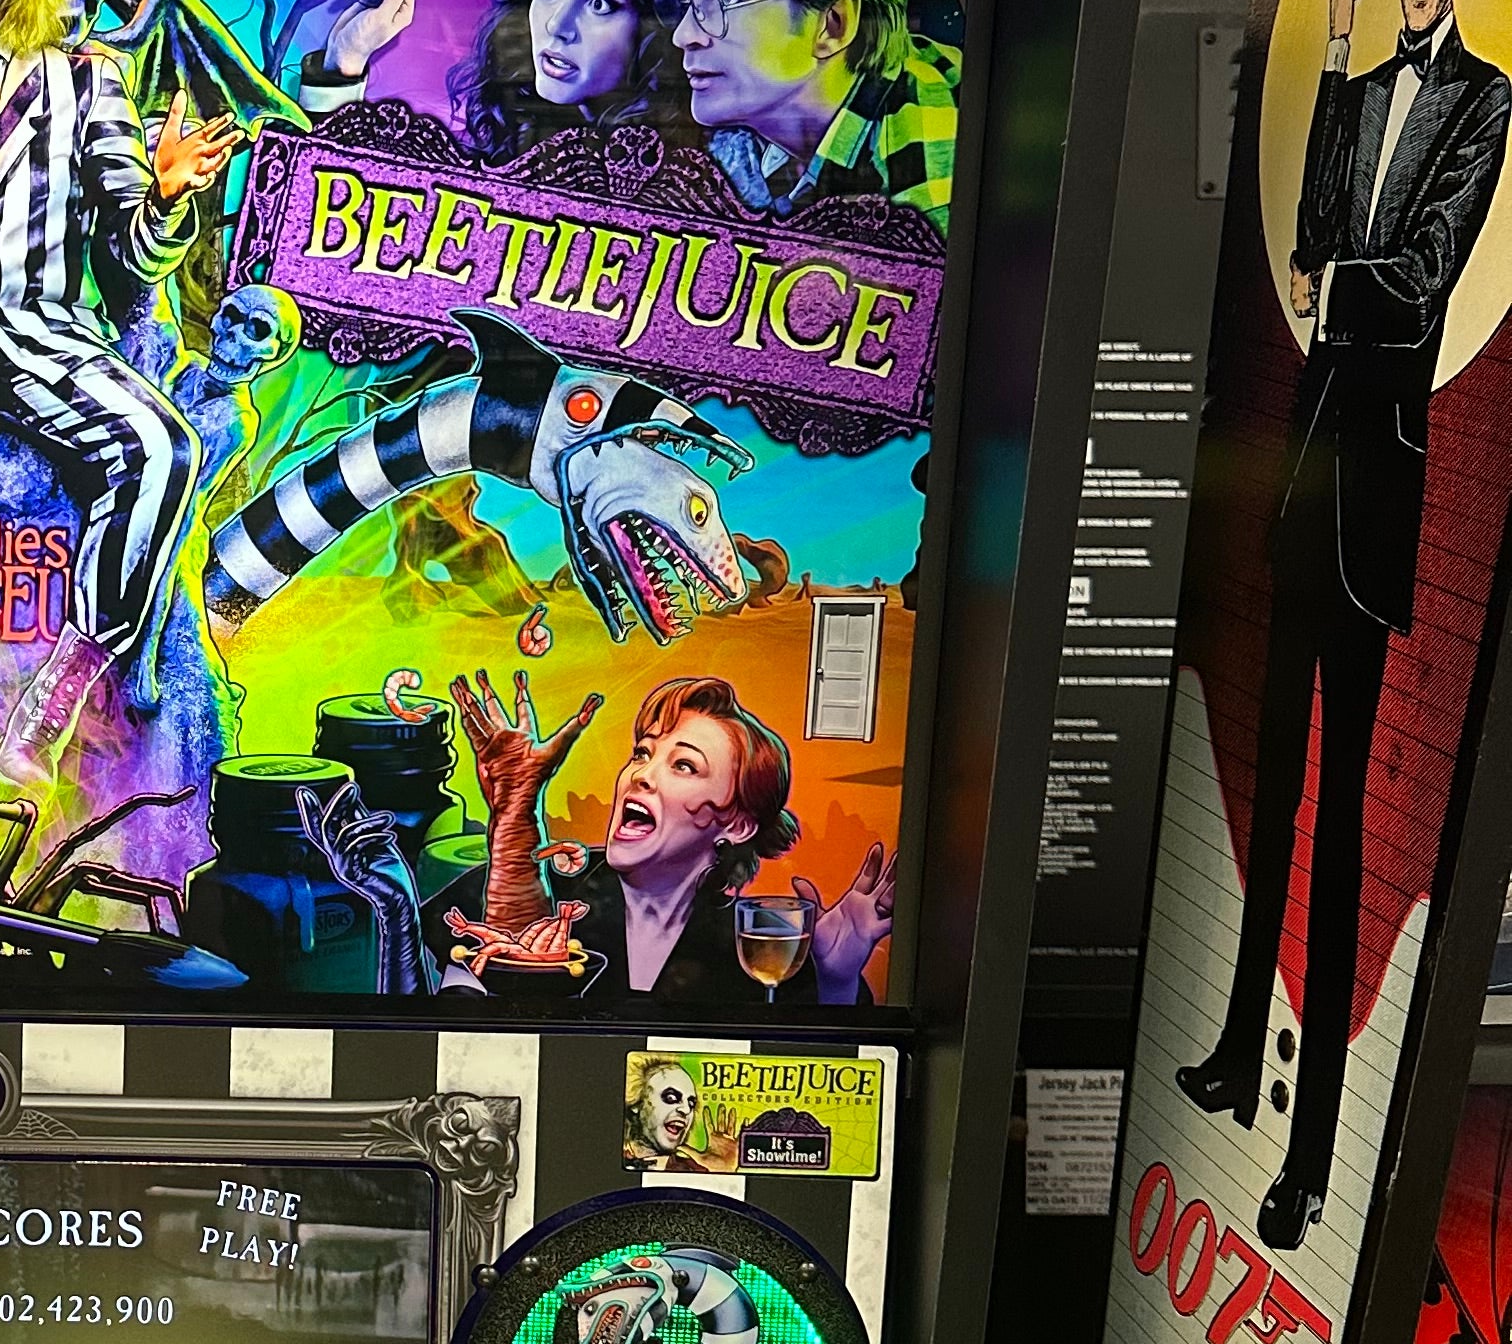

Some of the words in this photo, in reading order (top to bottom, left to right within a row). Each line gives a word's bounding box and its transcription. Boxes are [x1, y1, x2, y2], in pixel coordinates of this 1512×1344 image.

[303, 169, 913, 378] BEETLEJUICE
[16, 946, 34, 956] Inc.
[701, 1061, 876, 1098] BEETLEJUICE
[702, 1092, 792, 1104] COLLECTORS
[804, 1094, 873, 1106] EDITION
[747, 1148, 823, 1164] Showtime!
[771, 1136, 795, 1151] It's
[216, 1180, 302, 1221] FREE
[199, 1226, 299, 1270] PLAY!
